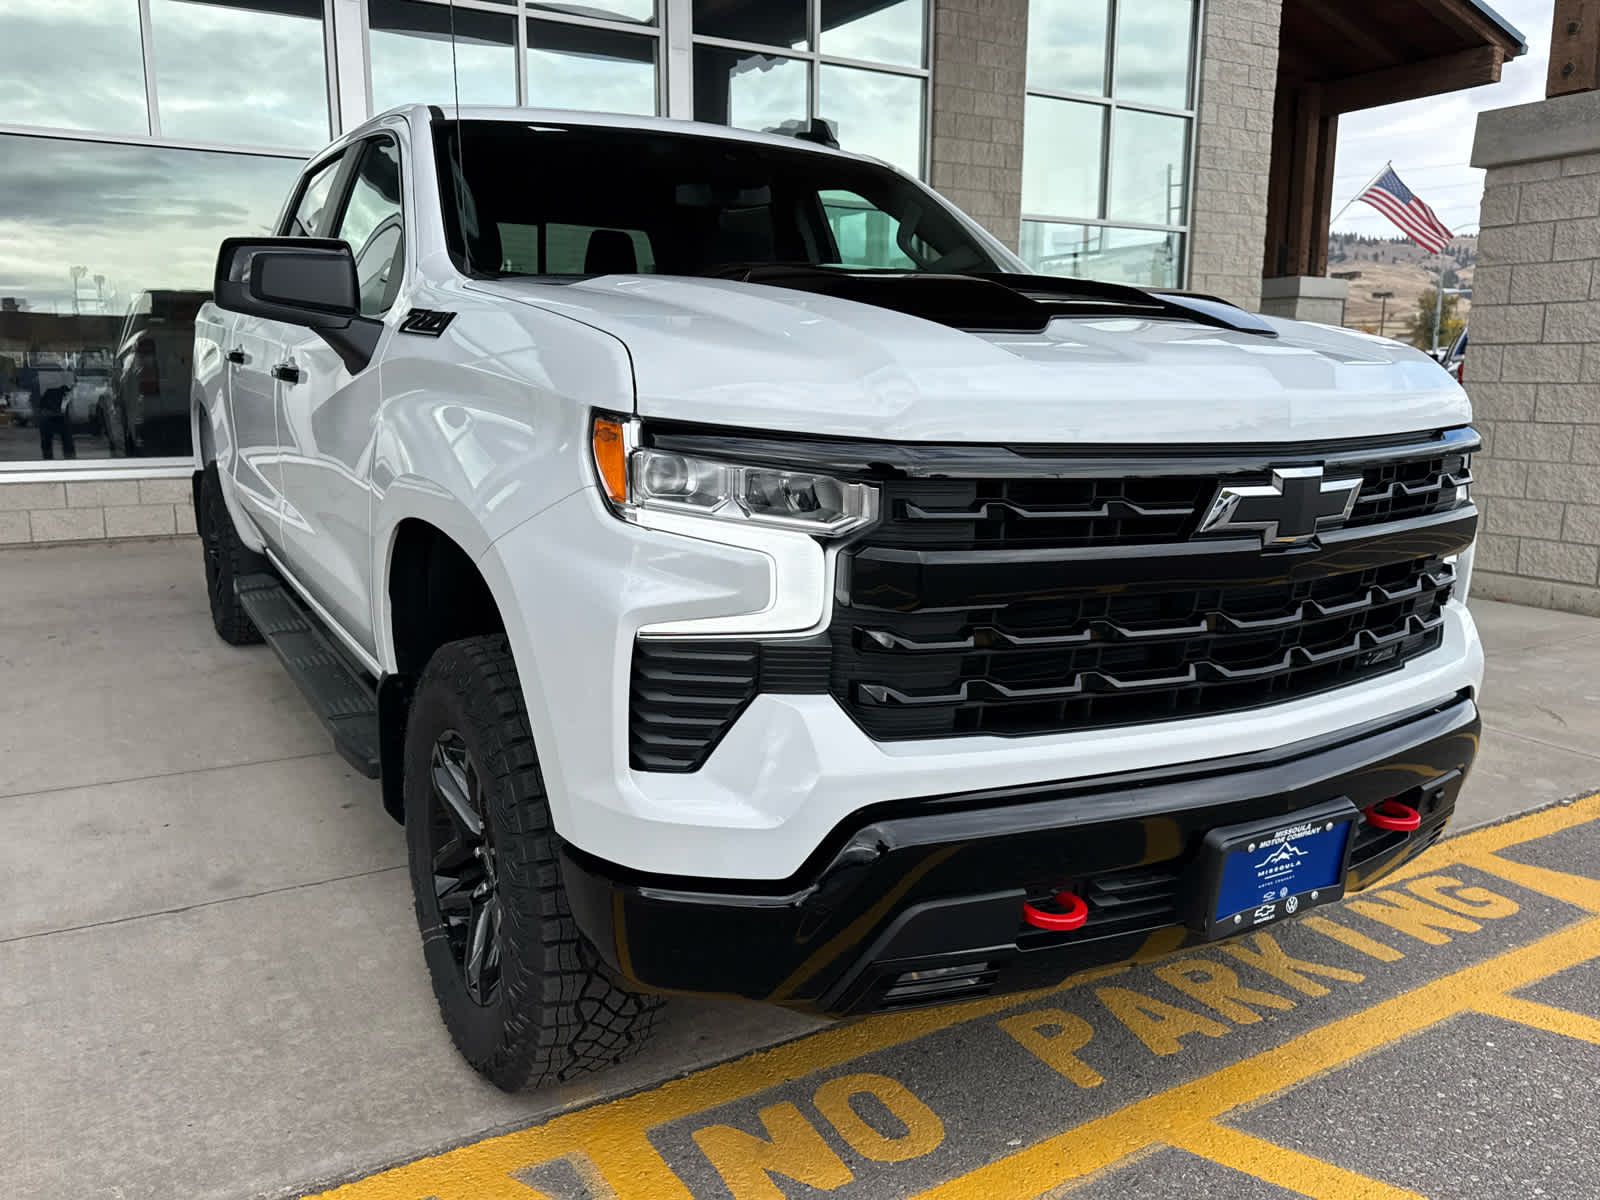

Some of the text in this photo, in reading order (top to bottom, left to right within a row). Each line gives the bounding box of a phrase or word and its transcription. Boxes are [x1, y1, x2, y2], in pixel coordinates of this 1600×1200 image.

[1259, 826, 1321, 848] MOTOR COMPANY
[1274, 823, 1311, 838] MISSOULA
[1258, 860, 1301, 877] MISSOULA
[691, 875, 1520, 1200] NO PARKING
